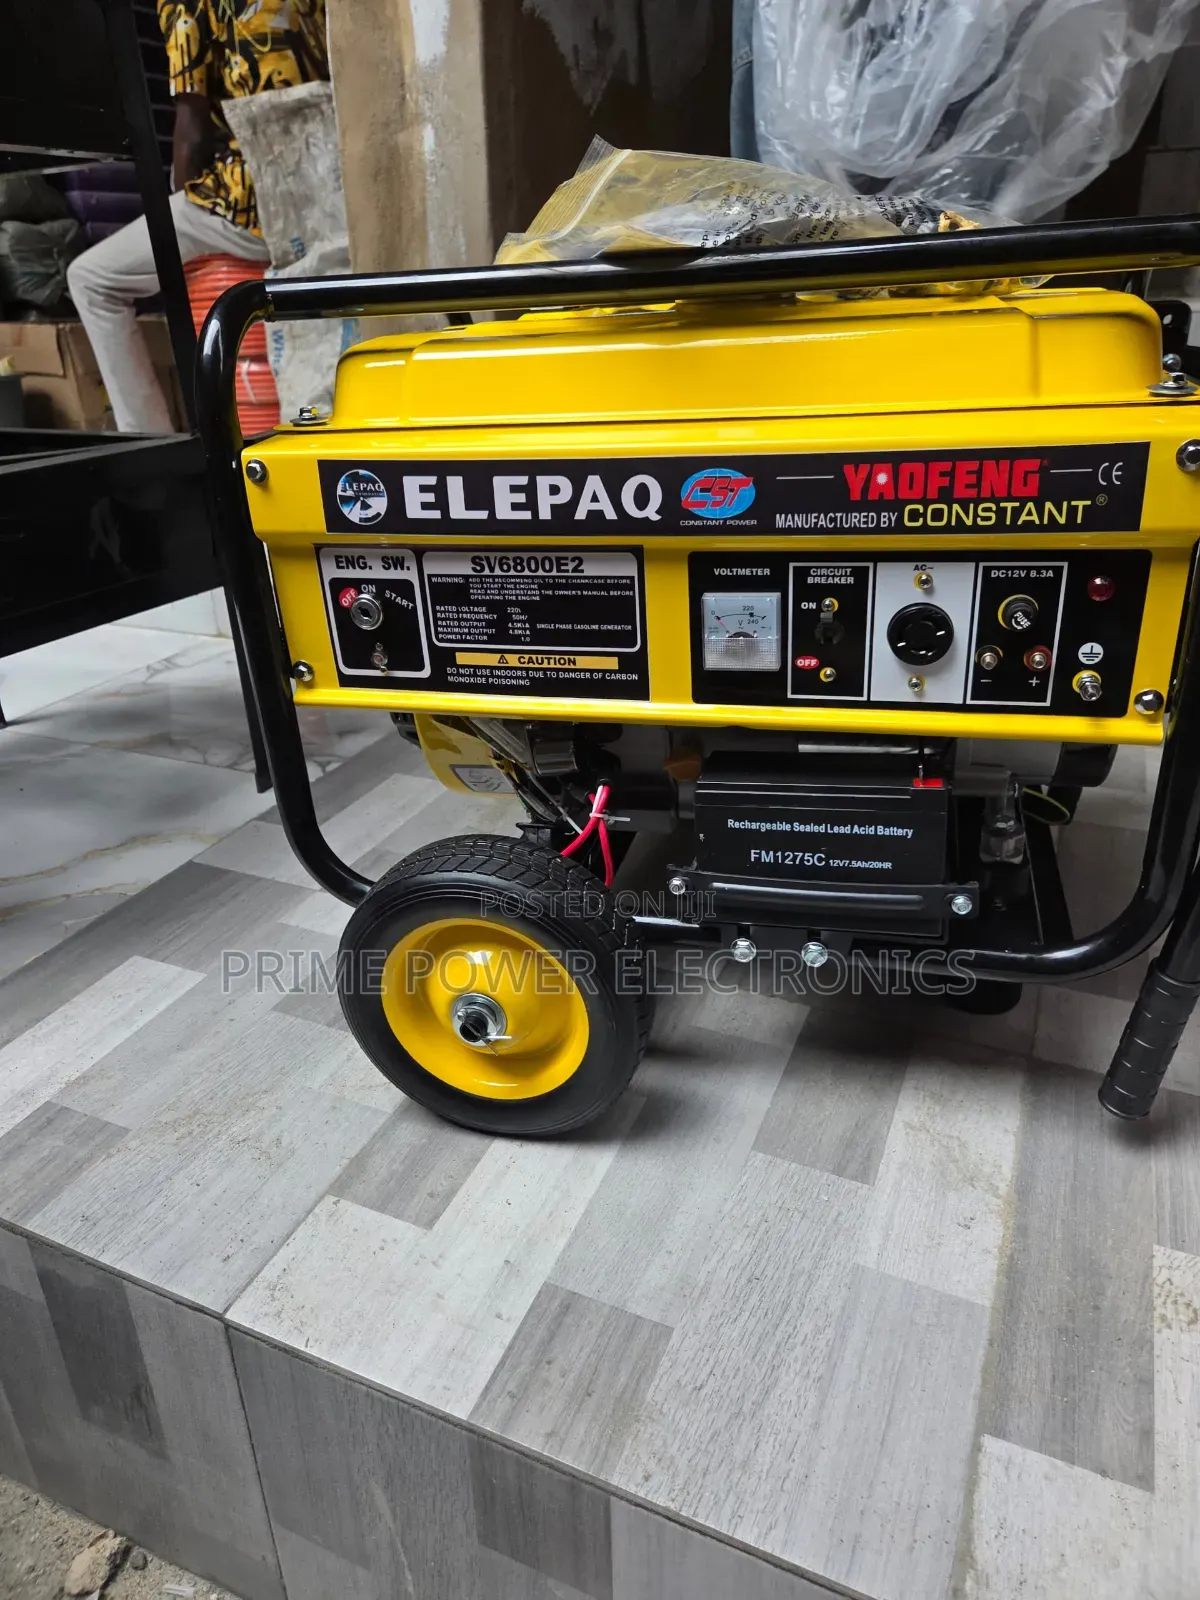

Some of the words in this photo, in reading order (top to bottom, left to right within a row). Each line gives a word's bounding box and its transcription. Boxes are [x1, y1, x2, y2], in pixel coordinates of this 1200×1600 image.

[842, 458, 1041, 500] YAOFENG
[1098, 462, 1123, 486] CE
[402, 474, 663, 522] ELEPAQ
[681, 475, 754, 510] CST
[775, 512, 877, 528] MANUFACTURED
[880, 512, 898, 528] BY
[903, 500, 1092, 527] CONSTANT
[334, 555, 373, 570] ENG.
[380, 555, 411, 571] SW.
[470, 555, 585, 574] SV6800E2
[713, 568, 771, 576] VOLTMETER
[807, 576, 855, 584] BREAKER
[810, 568, 852, 576] CIRCUIT
[991, 570, 1027, 578] DC12V
[1029, 570, 1054, 578] 8.3A
[341, 588, 357, 606] OFF
[361, 584, 376, 593] ON
[384, 590, 414, 610] START
[801, 602, 817, 610] ON
[1014, 611, 1032, 629] FUSE
[517, 656, 577, 667] CAUTION
[796, 659, 818, 667] OFF
[448, 675, 487, 684] MONOXIDE
[488, 677, 530, 686] POISONING
[492, 669, 527, 677] INDOORS
[558, 671, 591, 679] DANGER
[727, 819, 792, 833] Rechargeable
[793, 822, 825, 834] Sealed
[827, 823, 851, 834] Lead
[852, 825, 875, 835] Acid
[877, 825, 913, 839] Battery
[750, 850, 826, 867] FM1275C
[828, 859, 892, 870] 12V7.5Ah/20HR
